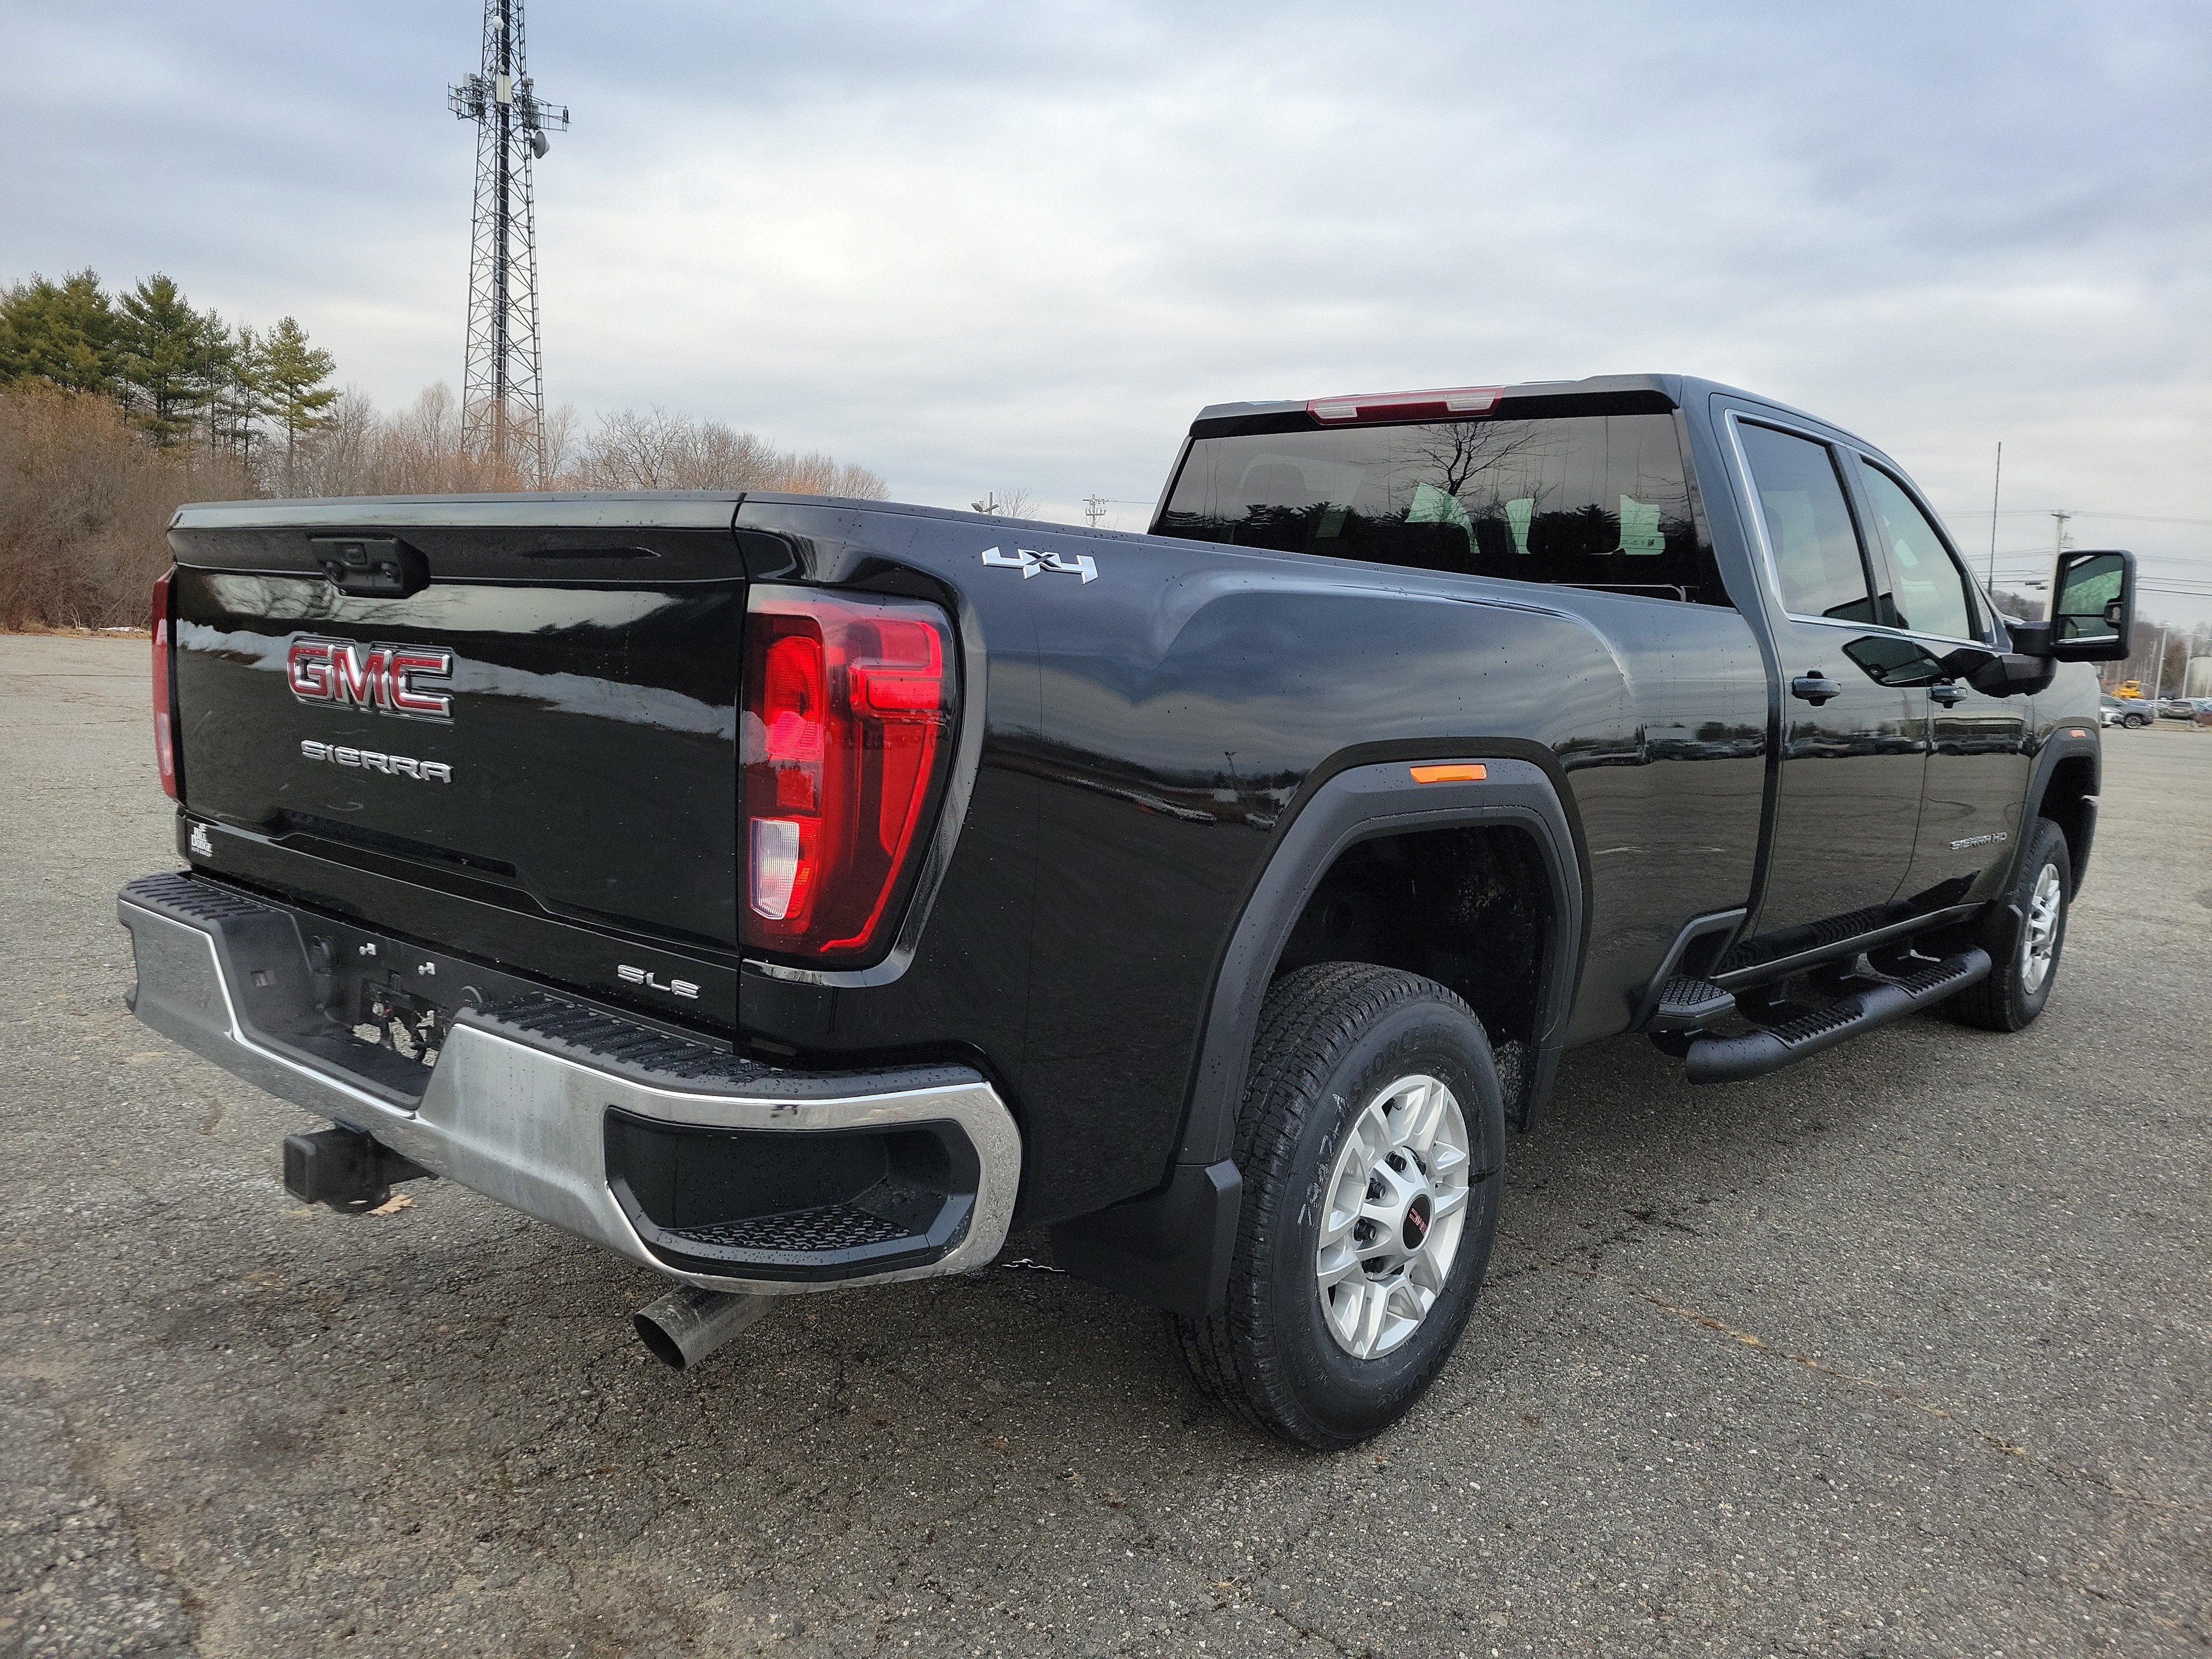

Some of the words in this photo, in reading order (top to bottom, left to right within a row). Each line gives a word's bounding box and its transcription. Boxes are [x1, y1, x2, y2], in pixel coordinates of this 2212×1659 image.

[287, 636, 454, 724] GMC
[301, 740, 454, 784] SIERRA
[1949, 834, 1991, 850] SIERRA
[617, 964, 702, 1000] SLE
[1409, 1207, 1427, 1237] GMC
